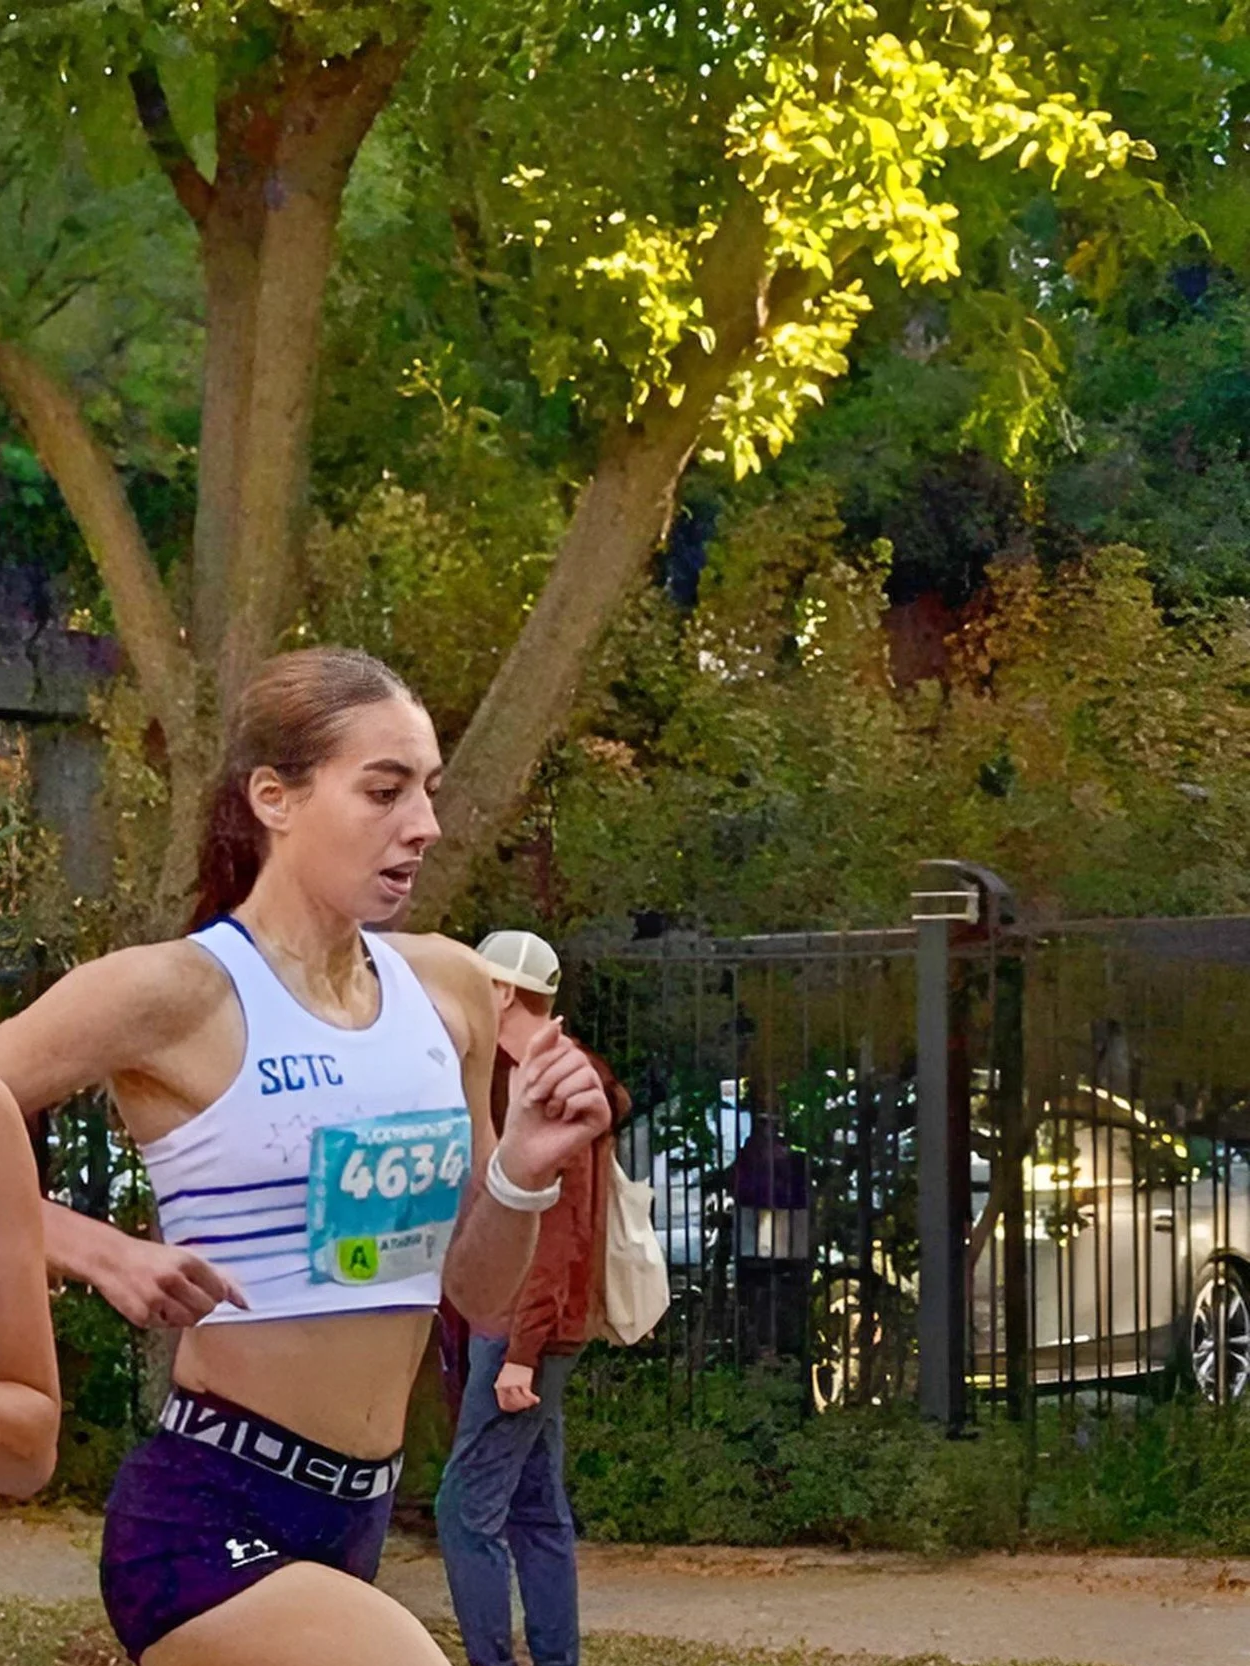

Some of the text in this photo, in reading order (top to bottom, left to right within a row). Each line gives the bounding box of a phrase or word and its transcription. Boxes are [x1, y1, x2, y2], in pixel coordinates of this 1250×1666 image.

[257, 1053, 344, 1096] SCTC
[339, 1140, 466, 1200] 4634
[349, 1245, 369, 1271] A
